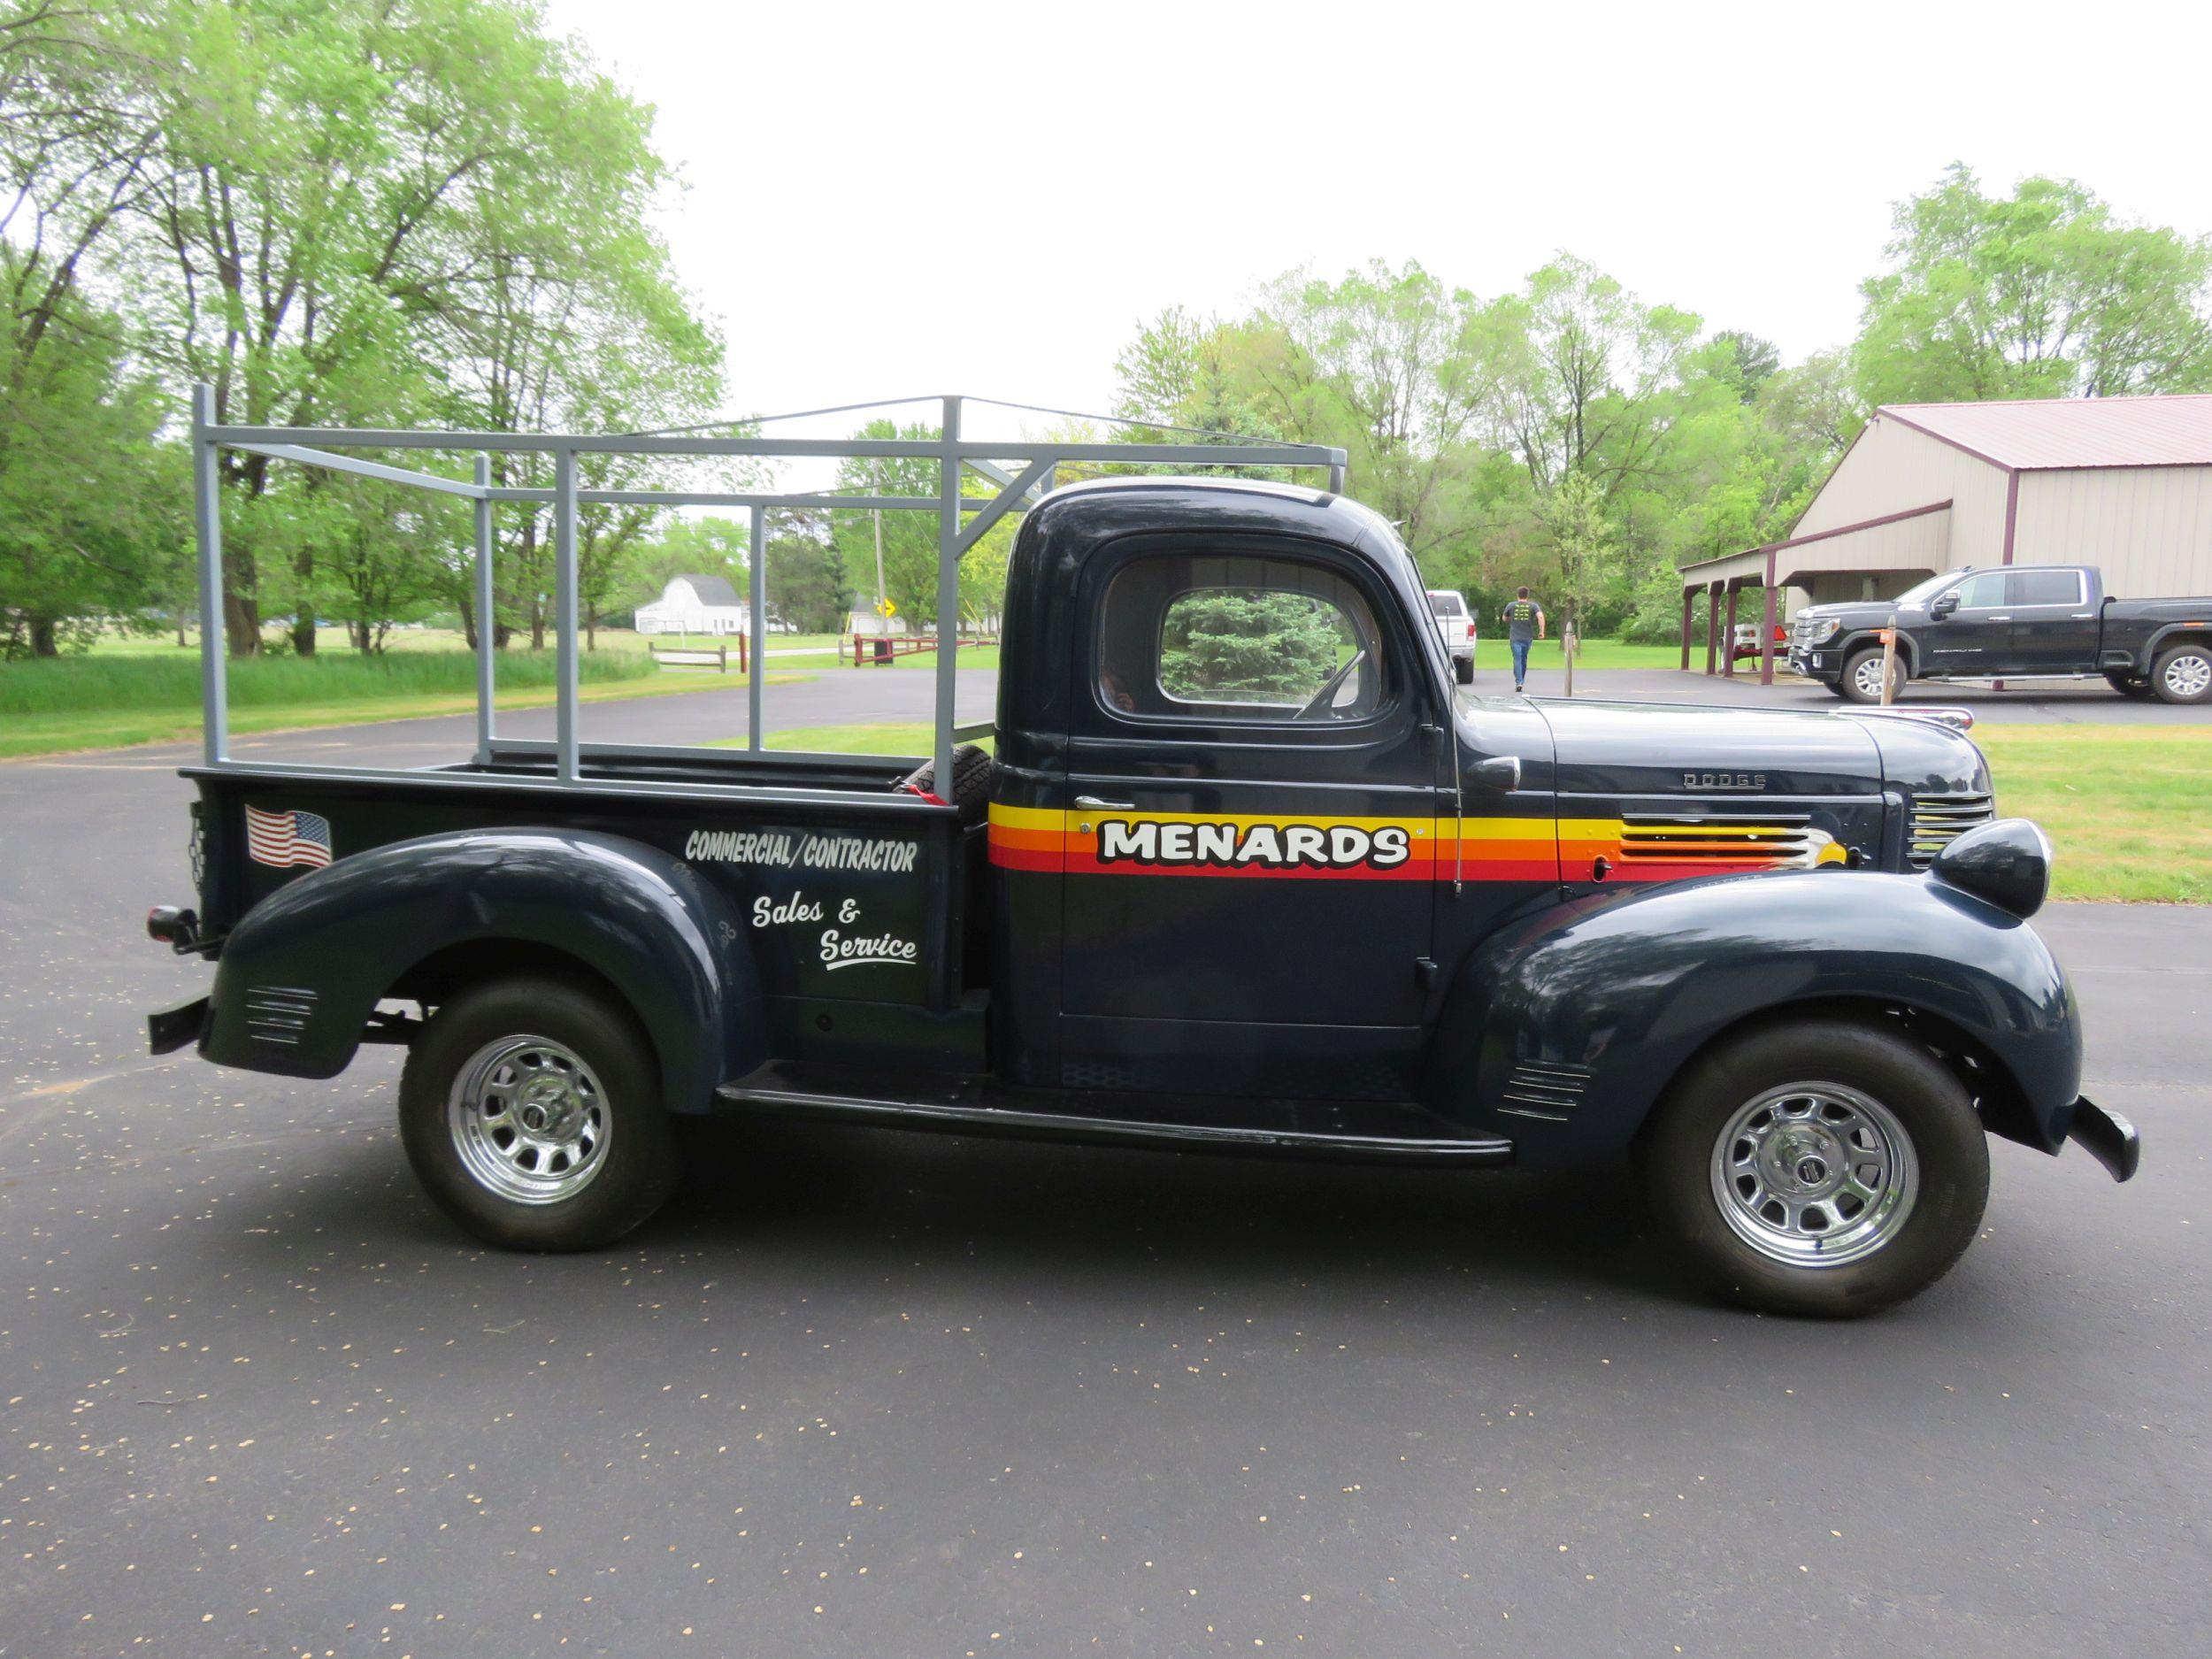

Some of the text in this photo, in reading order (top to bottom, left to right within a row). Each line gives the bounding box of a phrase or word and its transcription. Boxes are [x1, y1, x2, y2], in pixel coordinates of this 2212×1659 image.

[1684, 773, 1766, 787] DODGE
[686, 830, 918, 872] COMMERCIAL/CONTRACTOR
[1097, 820, 1410, 870] MENARDS
[752, 891, 861, 927] Sales &
[820, 929, 917, 961] Service
